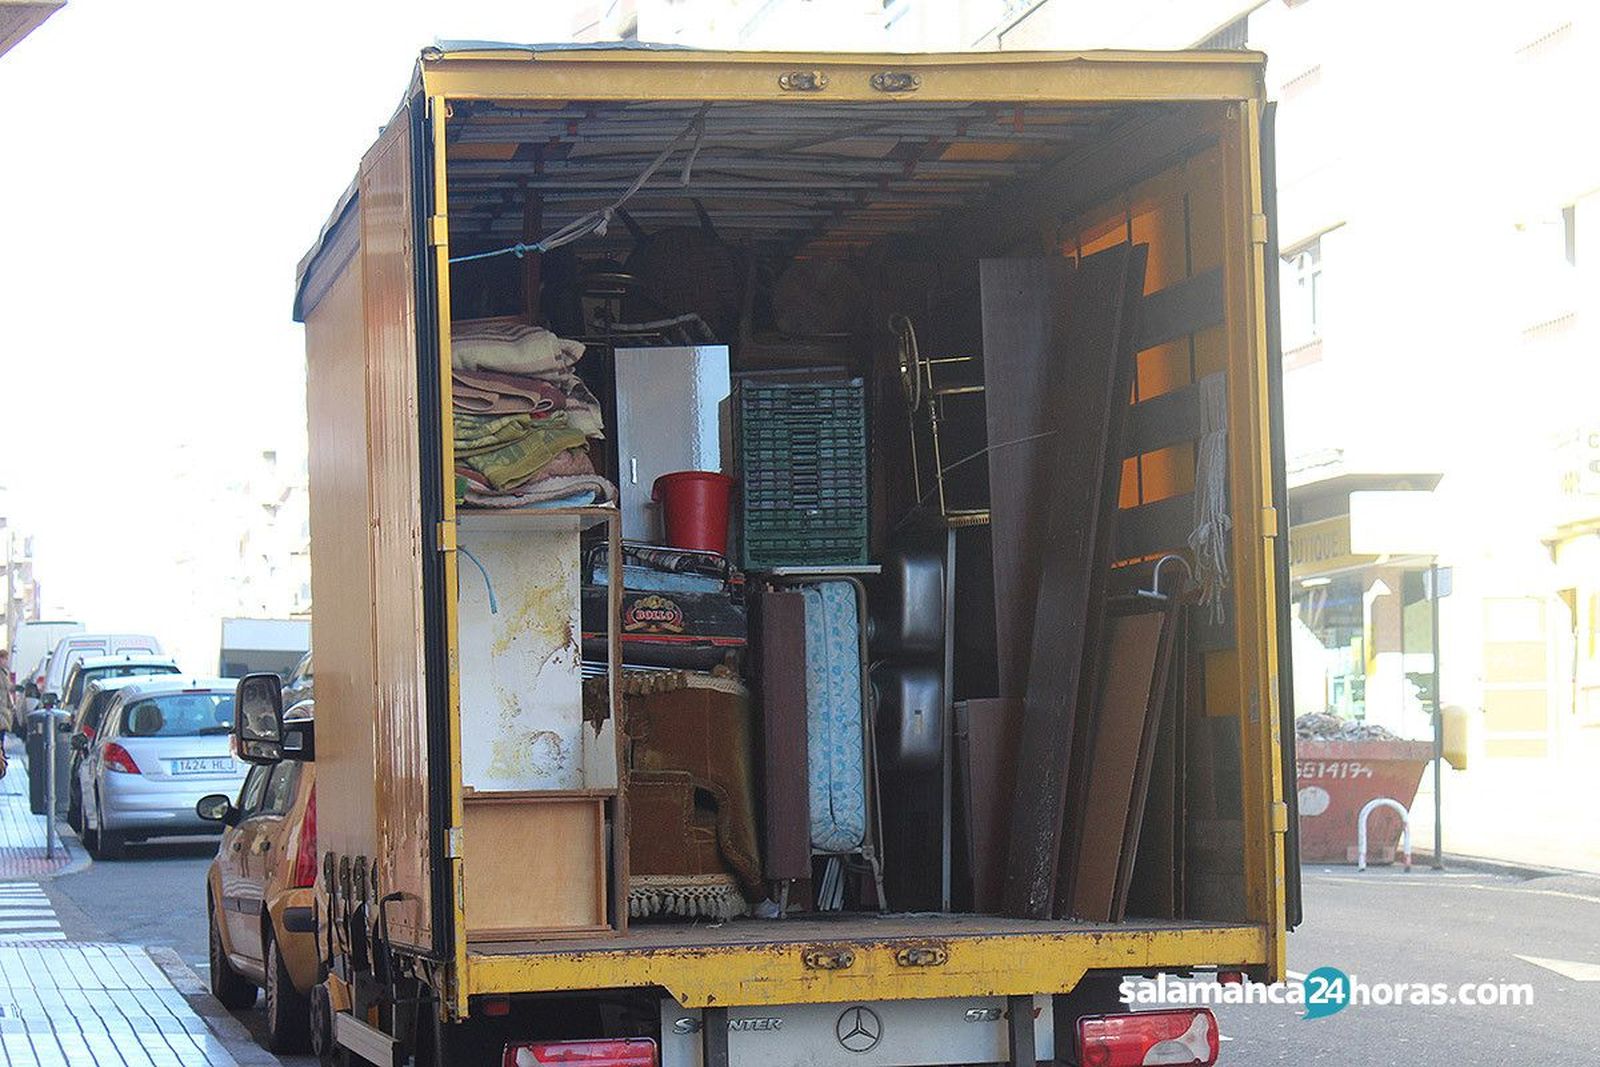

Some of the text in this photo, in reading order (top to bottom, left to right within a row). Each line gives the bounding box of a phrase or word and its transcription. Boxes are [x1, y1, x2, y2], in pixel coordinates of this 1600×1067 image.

[635, 609, 674, 621] BOLLO
[180, 760, 206, 771] 1424
[672, 1017, 784, 1035] SNTER
